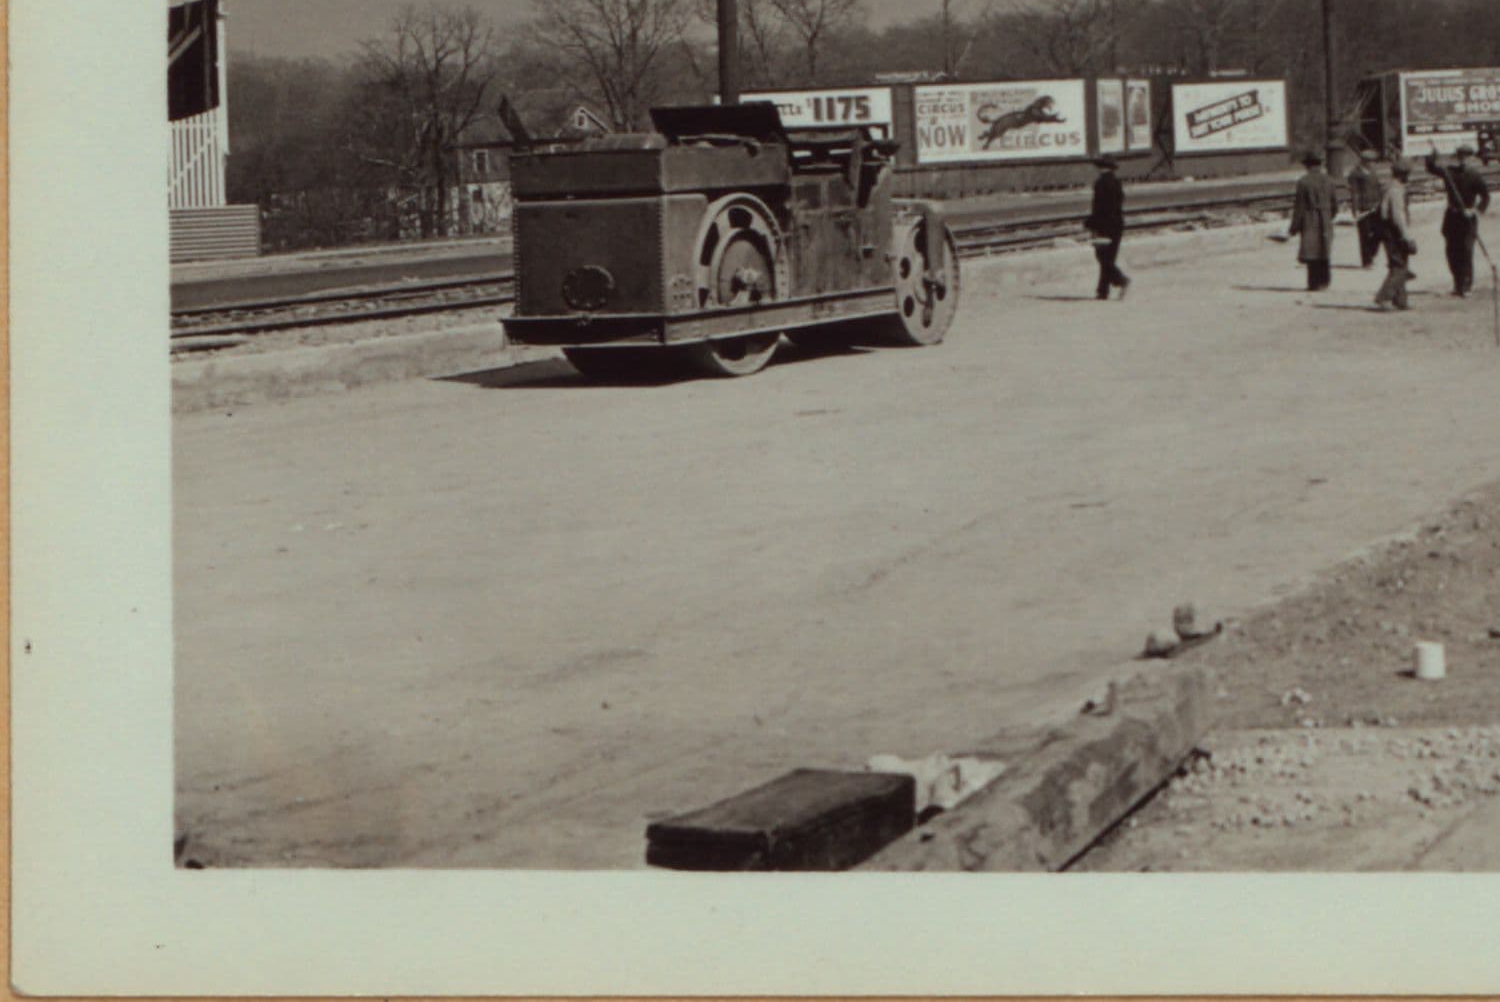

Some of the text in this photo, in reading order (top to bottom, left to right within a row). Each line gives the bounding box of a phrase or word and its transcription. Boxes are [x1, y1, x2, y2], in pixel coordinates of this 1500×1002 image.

[1416, 85, 1465, 103] JULIUS
[918, 125, 966, 149] NOW
[1001, 131, 1080, 149] CIRCUS
